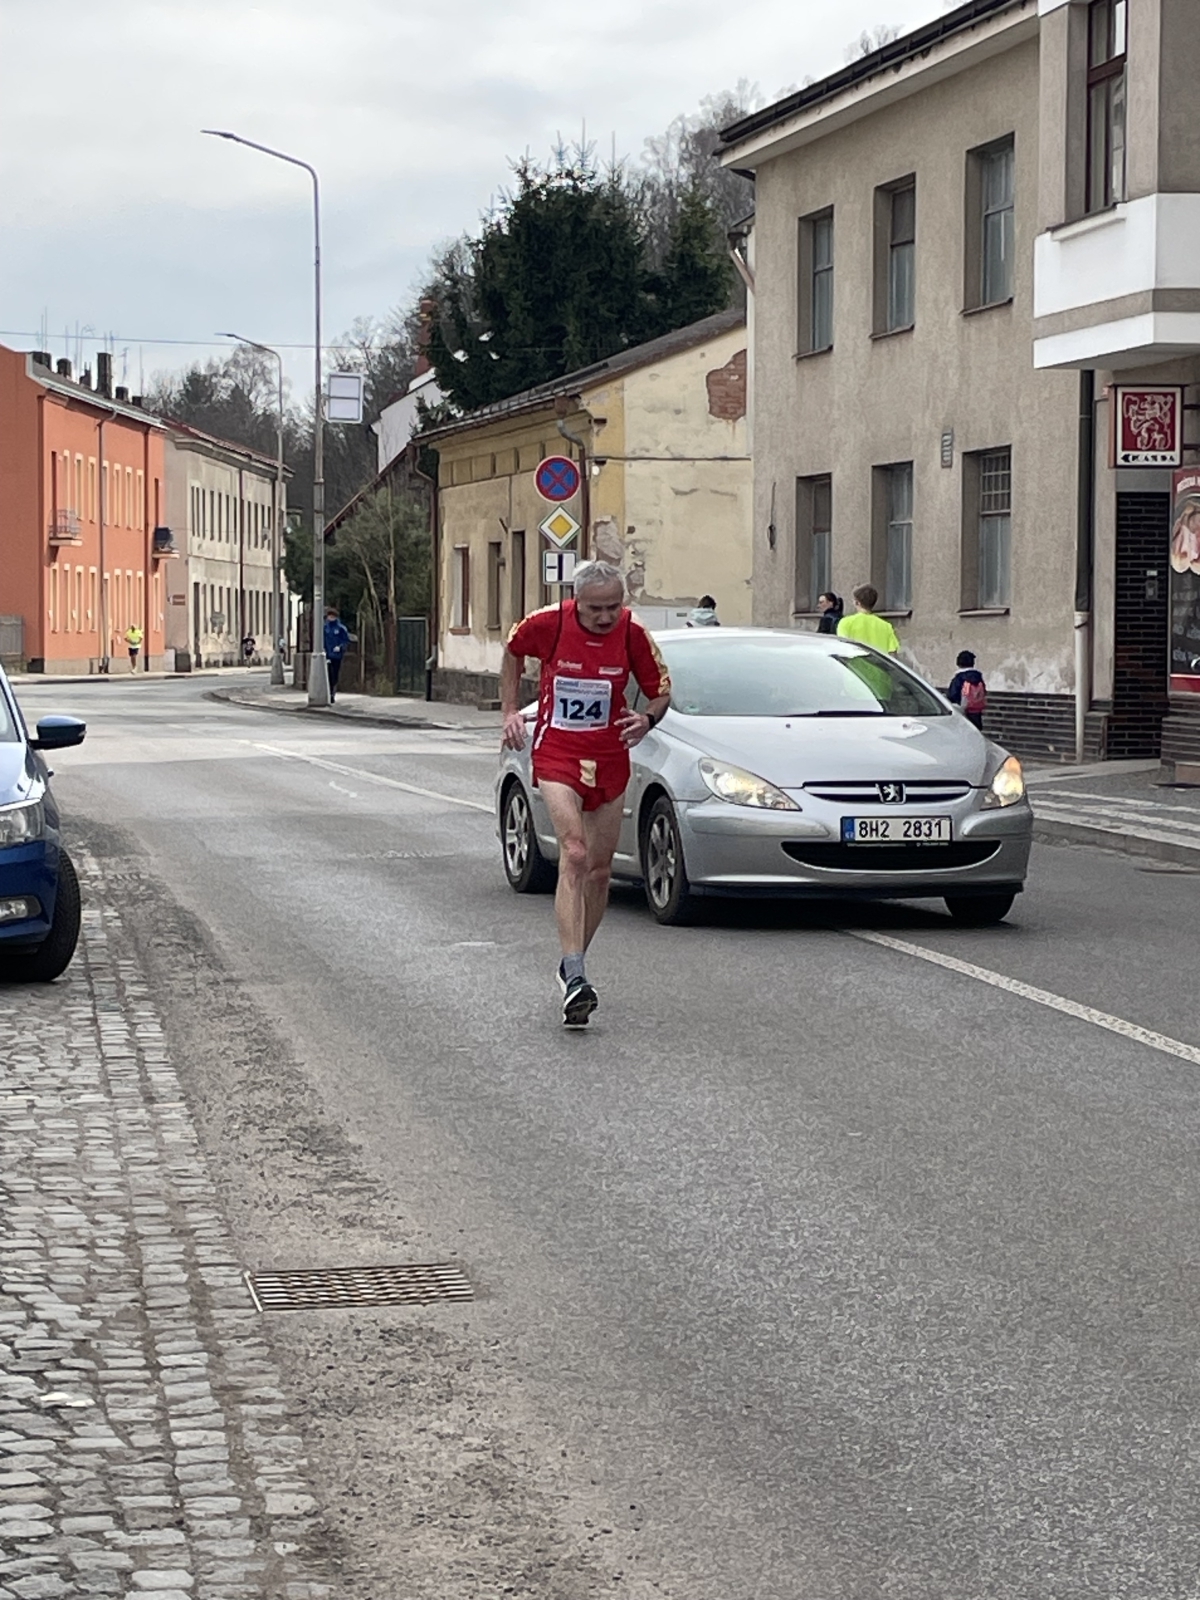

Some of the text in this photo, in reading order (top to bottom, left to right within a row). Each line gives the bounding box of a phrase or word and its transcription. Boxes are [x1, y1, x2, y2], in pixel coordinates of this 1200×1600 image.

[559, 698, 603, 720] 124
[858, 820, 890, 838] 8H2
[902, 820, 942, 838] 2831
